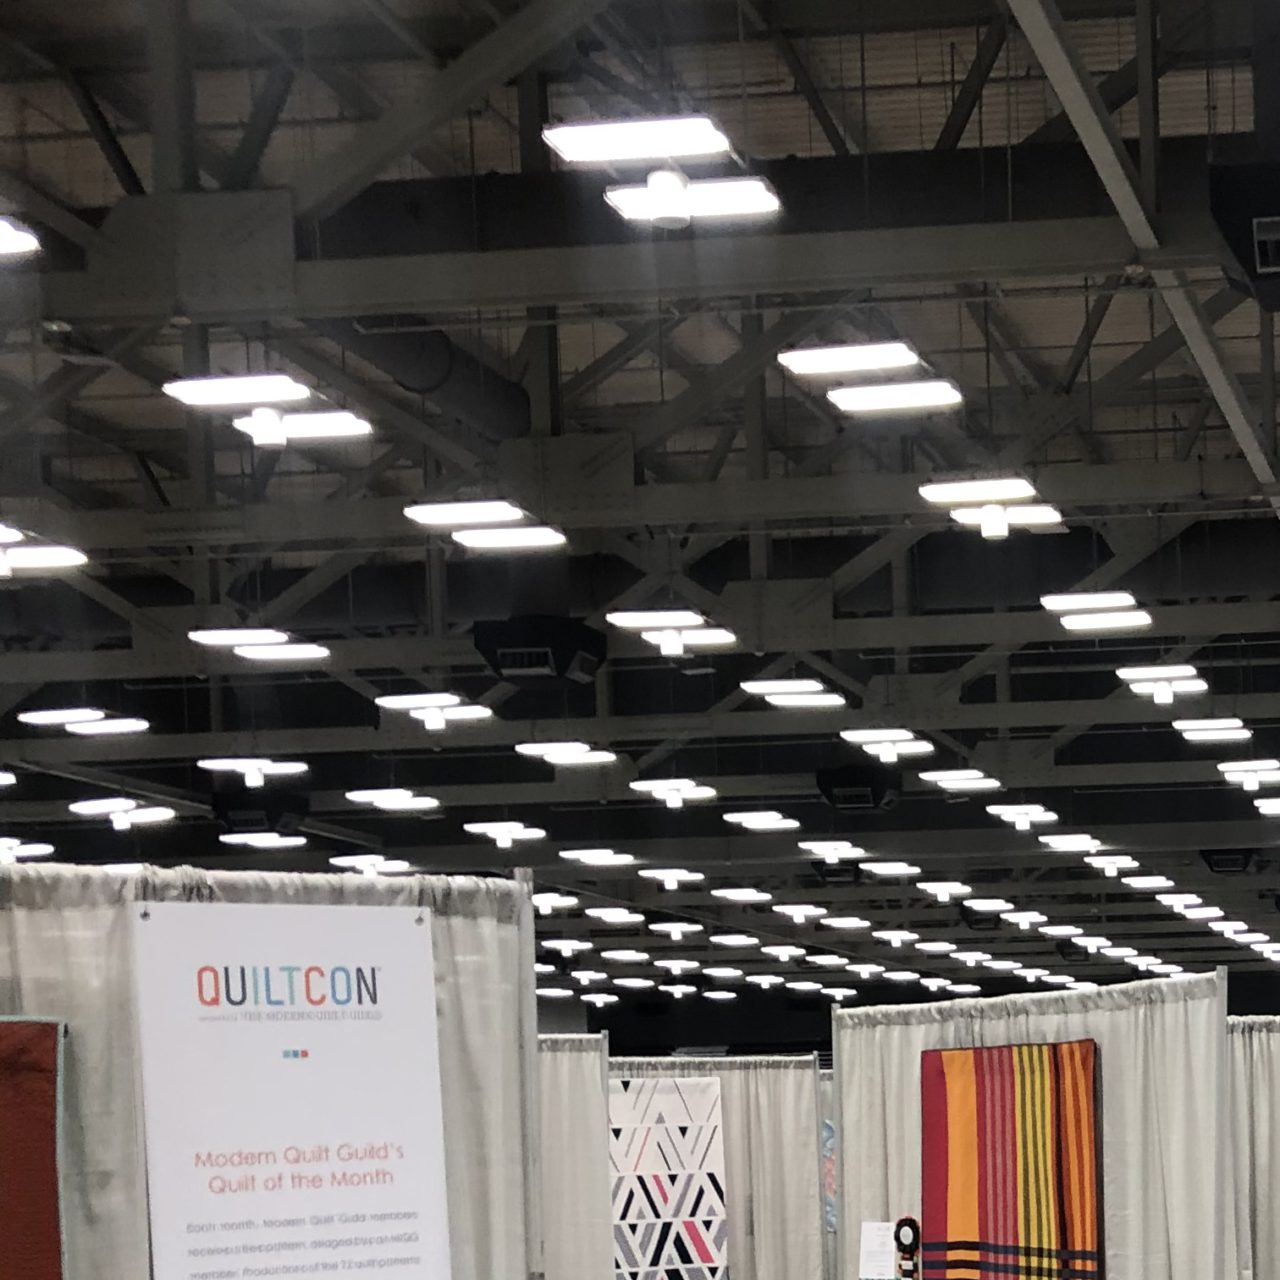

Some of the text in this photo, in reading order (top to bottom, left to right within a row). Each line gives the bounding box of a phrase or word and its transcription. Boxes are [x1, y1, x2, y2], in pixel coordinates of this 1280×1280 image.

[197, 966, 378, 1007] QUILTCON
[194, 1142, 404, 1168] Modern Quilt Guild's
[208, 1169, 394, 1194] Quilt of the Month
